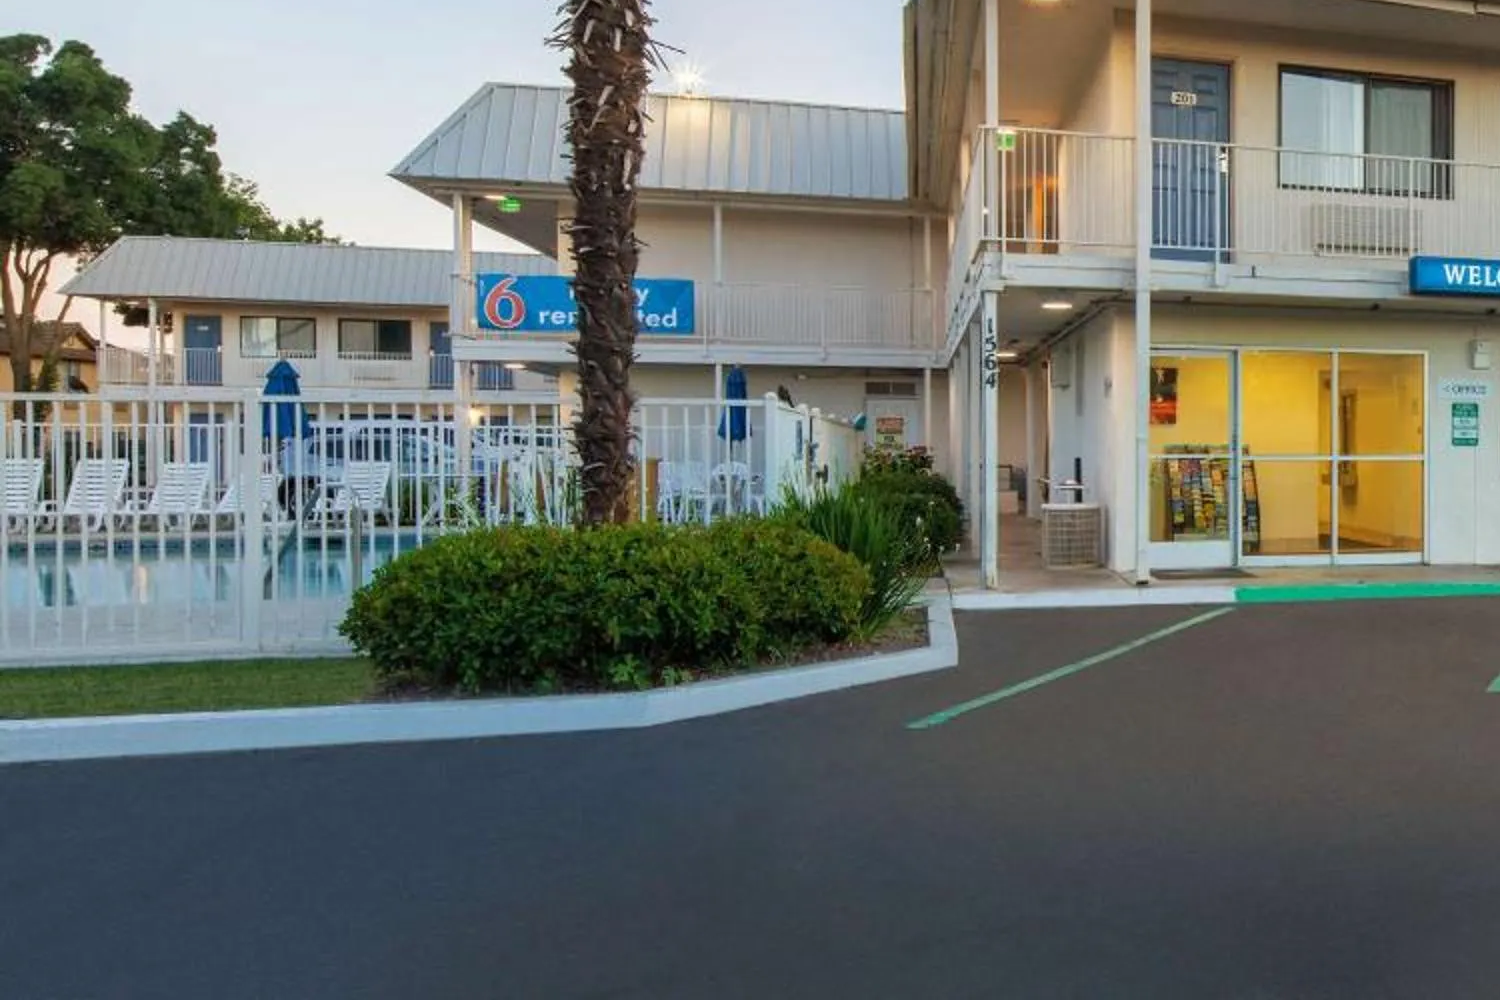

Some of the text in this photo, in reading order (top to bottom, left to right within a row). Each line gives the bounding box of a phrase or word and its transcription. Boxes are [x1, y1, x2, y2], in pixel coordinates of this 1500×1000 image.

[484, 277, 526, 328] 6
[539, 307, 677, 328] rented
[984, 318, 996, 389] 1564
